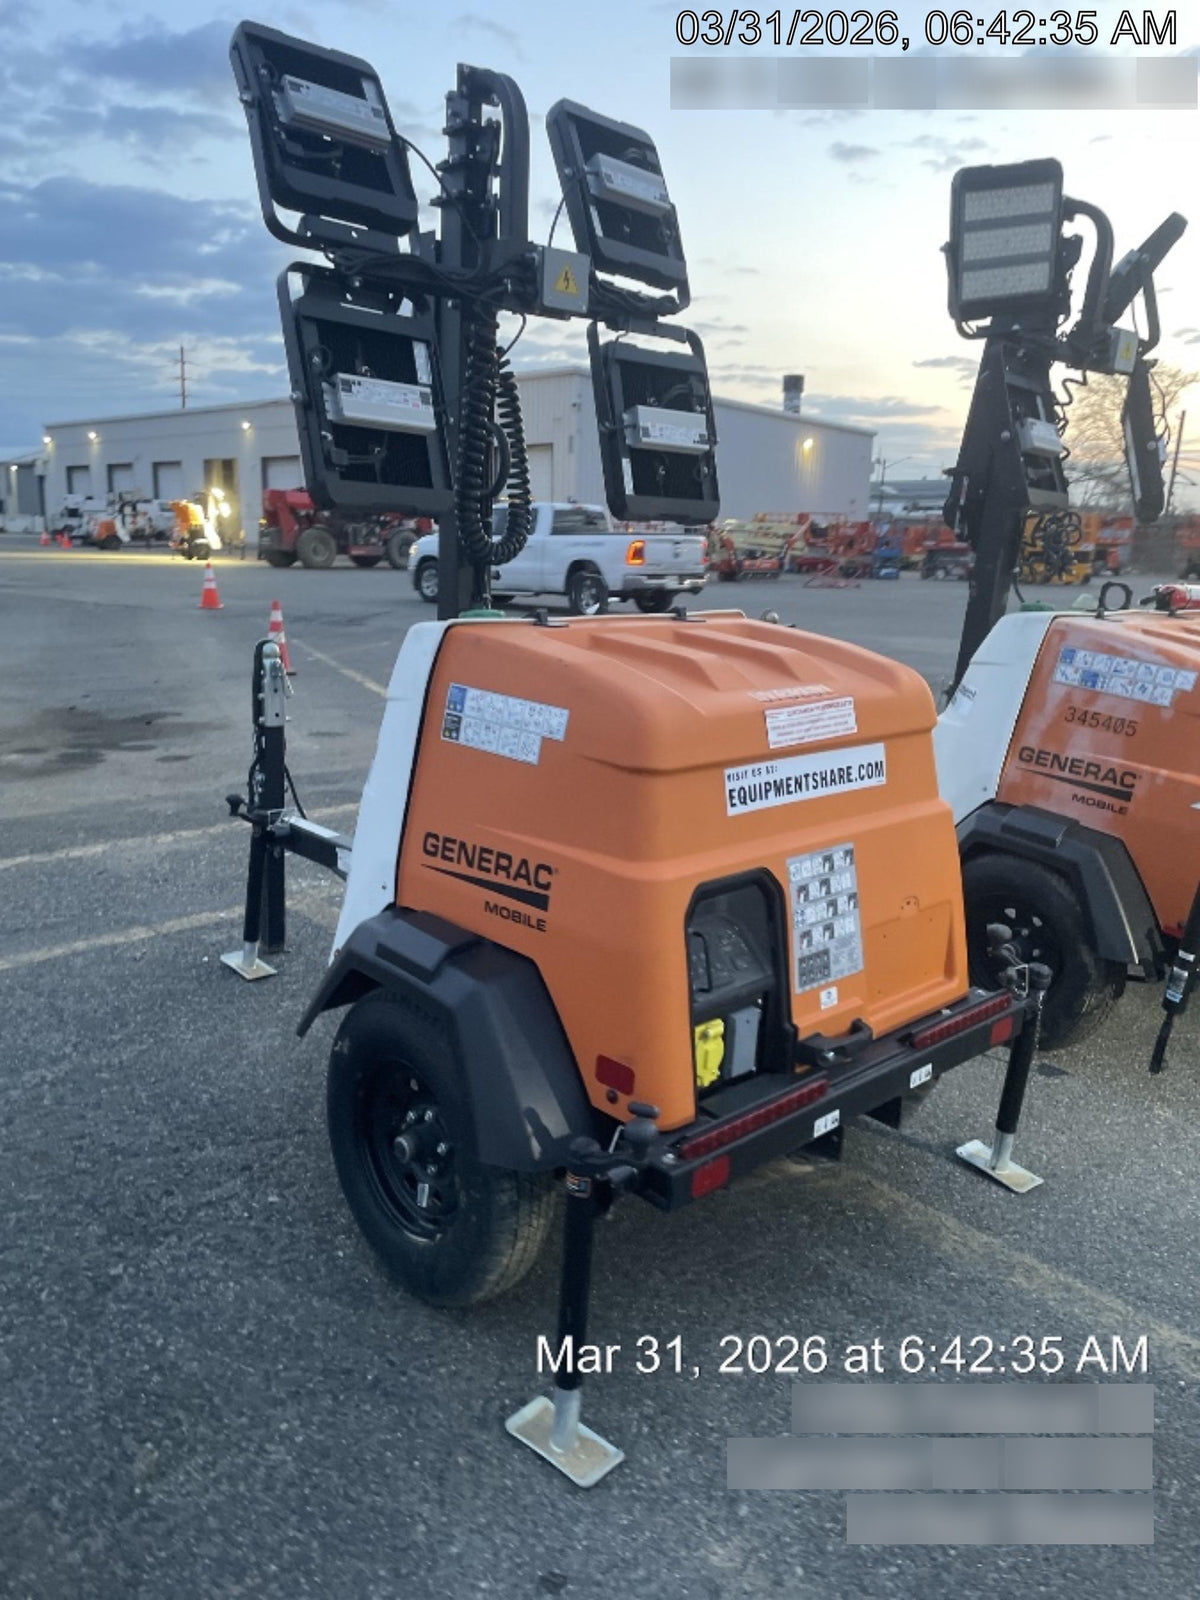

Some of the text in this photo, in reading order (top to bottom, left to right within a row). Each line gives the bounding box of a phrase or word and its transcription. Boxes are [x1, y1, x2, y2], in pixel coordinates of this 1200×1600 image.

[1064, 706, 1138, 737] 345405
[726, 770, 748, 783] VISIT
[728, 760, 885, 808] EQUIPMENTSHARE.COM
[1018, 746, 1138, 789] GENERAC
[1071, 793, 1130, 815] MOBILE
[422, 831, 554, 892] GENERAC
[484, 900, 547, 933] MOBILE
